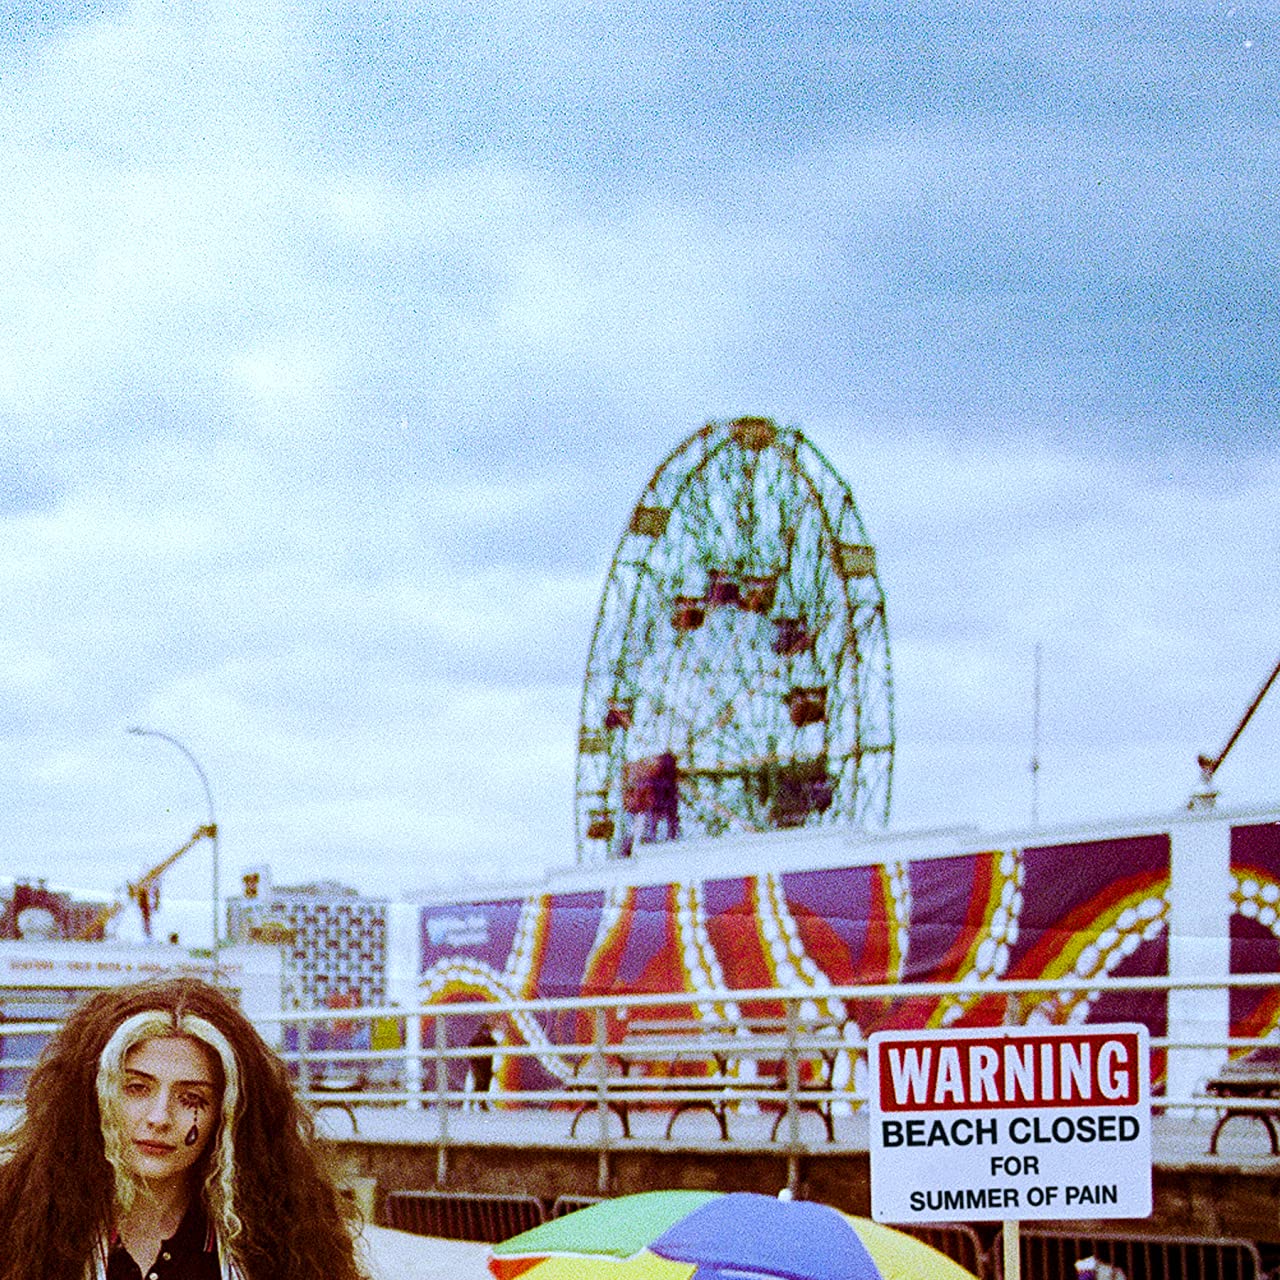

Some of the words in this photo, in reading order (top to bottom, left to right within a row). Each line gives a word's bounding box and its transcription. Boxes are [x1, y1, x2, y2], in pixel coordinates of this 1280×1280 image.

[888, 1040, 1130, 1105] WARNING
[882, 1118, 998, 1147] BEACH
[1008, 1115, 1140, 1145] CLOSED
[991, 1156, 1039, 1176] FOR
[910, 1188, 1019, 1212] SUMMER
[1026, 1186, 1058, 1206] OF
[1066, 1185, 1118, 1205] PAIN
